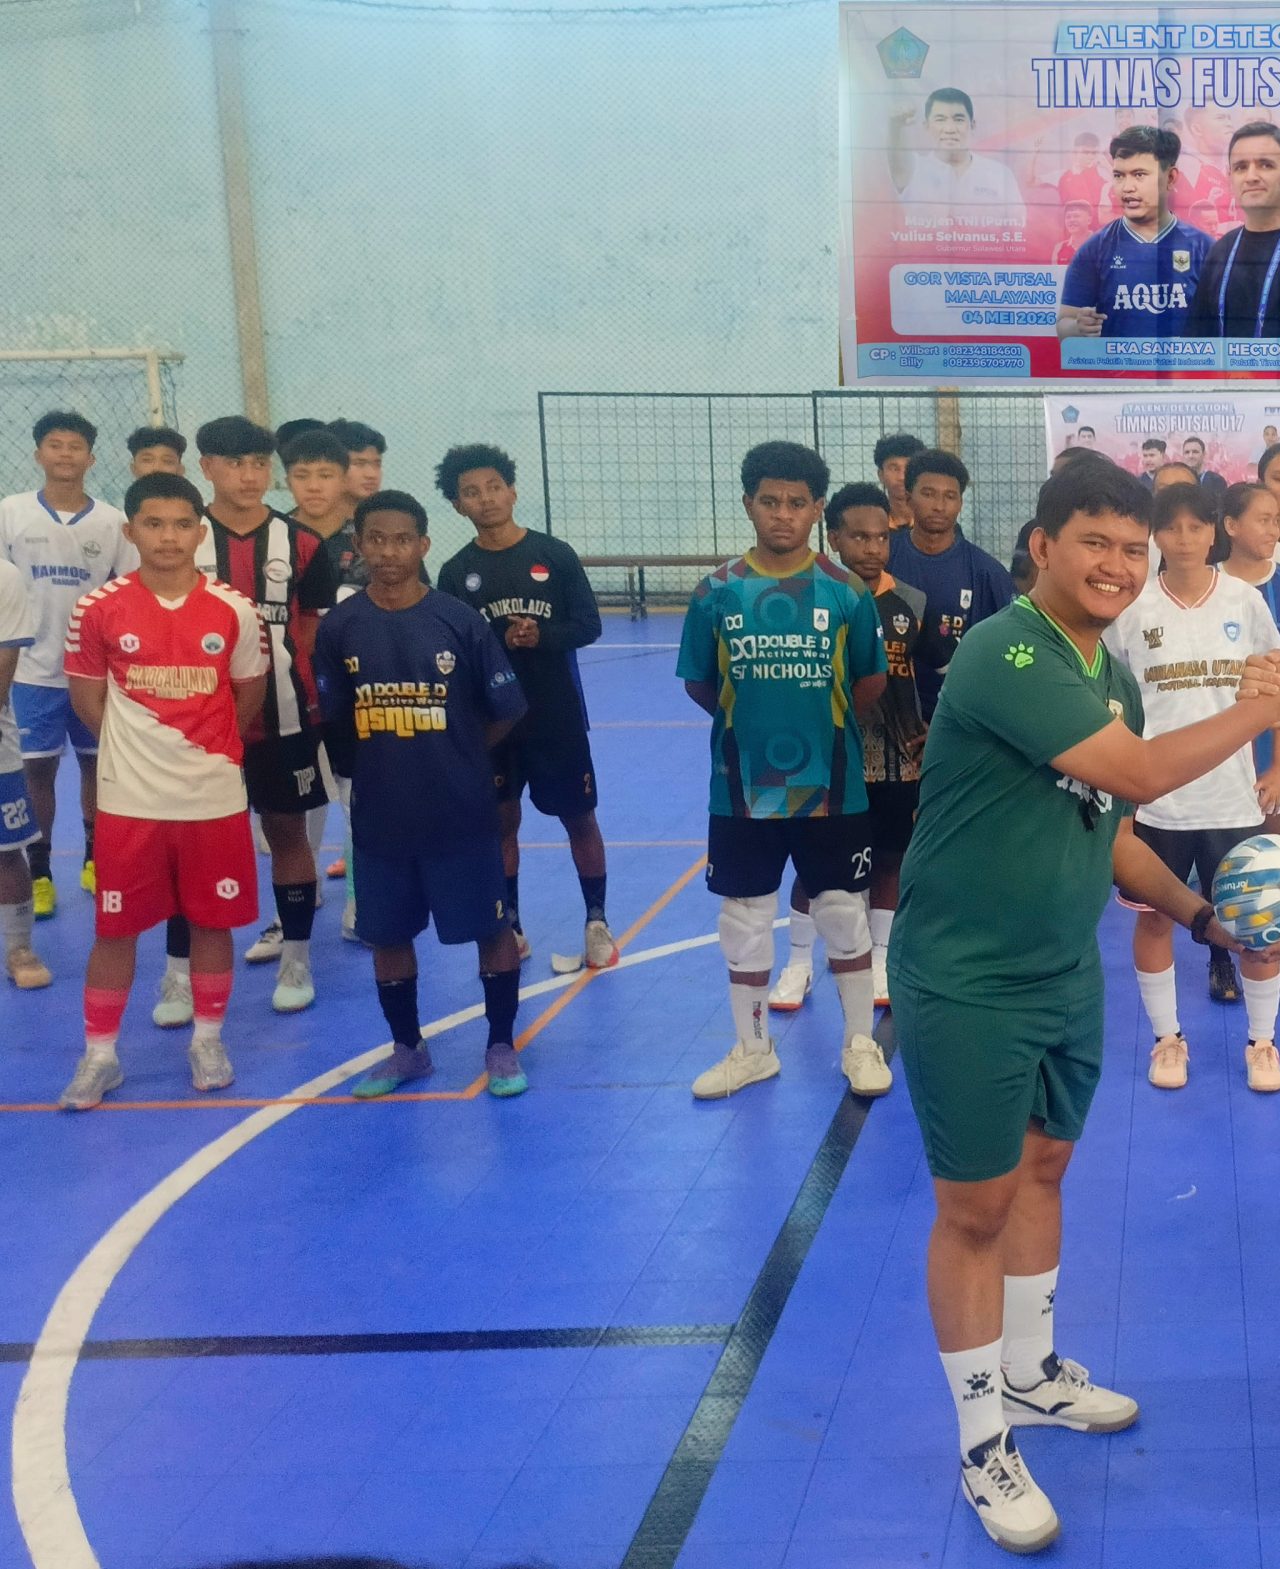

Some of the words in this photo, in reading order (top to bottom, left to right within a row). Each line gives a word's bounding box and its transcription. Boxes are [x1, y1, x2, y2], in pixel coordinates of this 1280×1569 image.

[1068, 24, 1186, 49] TALENT
[1032, 58, 1182, 108] TIMNAS
[956, 215, 978, 226] TNI
[891, 231, 933, 241] Yulius
[936, 231, 999, 243] Selvanus,
[1002, 231, 1027, 242] S.E.
[904, 272, 942, 287] GOR
[944, 272, 992, 287] VISTA
[993, 272, 1056, 287] FUTSAL
[945, 290, 1056, 305] MALALAYANG
[1113, 283, 1187, 314] AQUA
[962, 311, 986, 325] 04
[988, 311, 1015, 325] MEI
[1017, 311, 1056, 325] 2026
[900, 345, 939, 355] Wilbert
[1106, 342, 1140, 354] EKA
[1141, 342, 1215, 355] SANJAYA
[900, 357, 923, 368] Billy
[1230, 358, 1259, 367] Pelatih
[1127, 404, 1168, 413] TALENT
[1170, 404, 1229, 413] DETECTION
[1114, 415, 1167, 434] TIMNAS
[1170, 415, 1218, 433] FUTSAL
[1221, 414, 1245, 433] U17
[488, 597, 552, 618] NIKOLAUS
[758, 635, 817, 649] DOUBLE
[821, 637, 830, 650] D
[758, 650, 798, 658] Active
[732, 665, 747, 679] ST
[753, 663, 833, 679] NICHOLAS
[374, 682, 430, 697] DOUBLE
[434, 682, 447, 697] D
[375, 697, 414, 706] Active
[1, 798, 30, 829] 22
[851, 847, 872, 880] 29
[102, 891, 123, 913] 18
[963, 1386, 995, 1401] KELME
